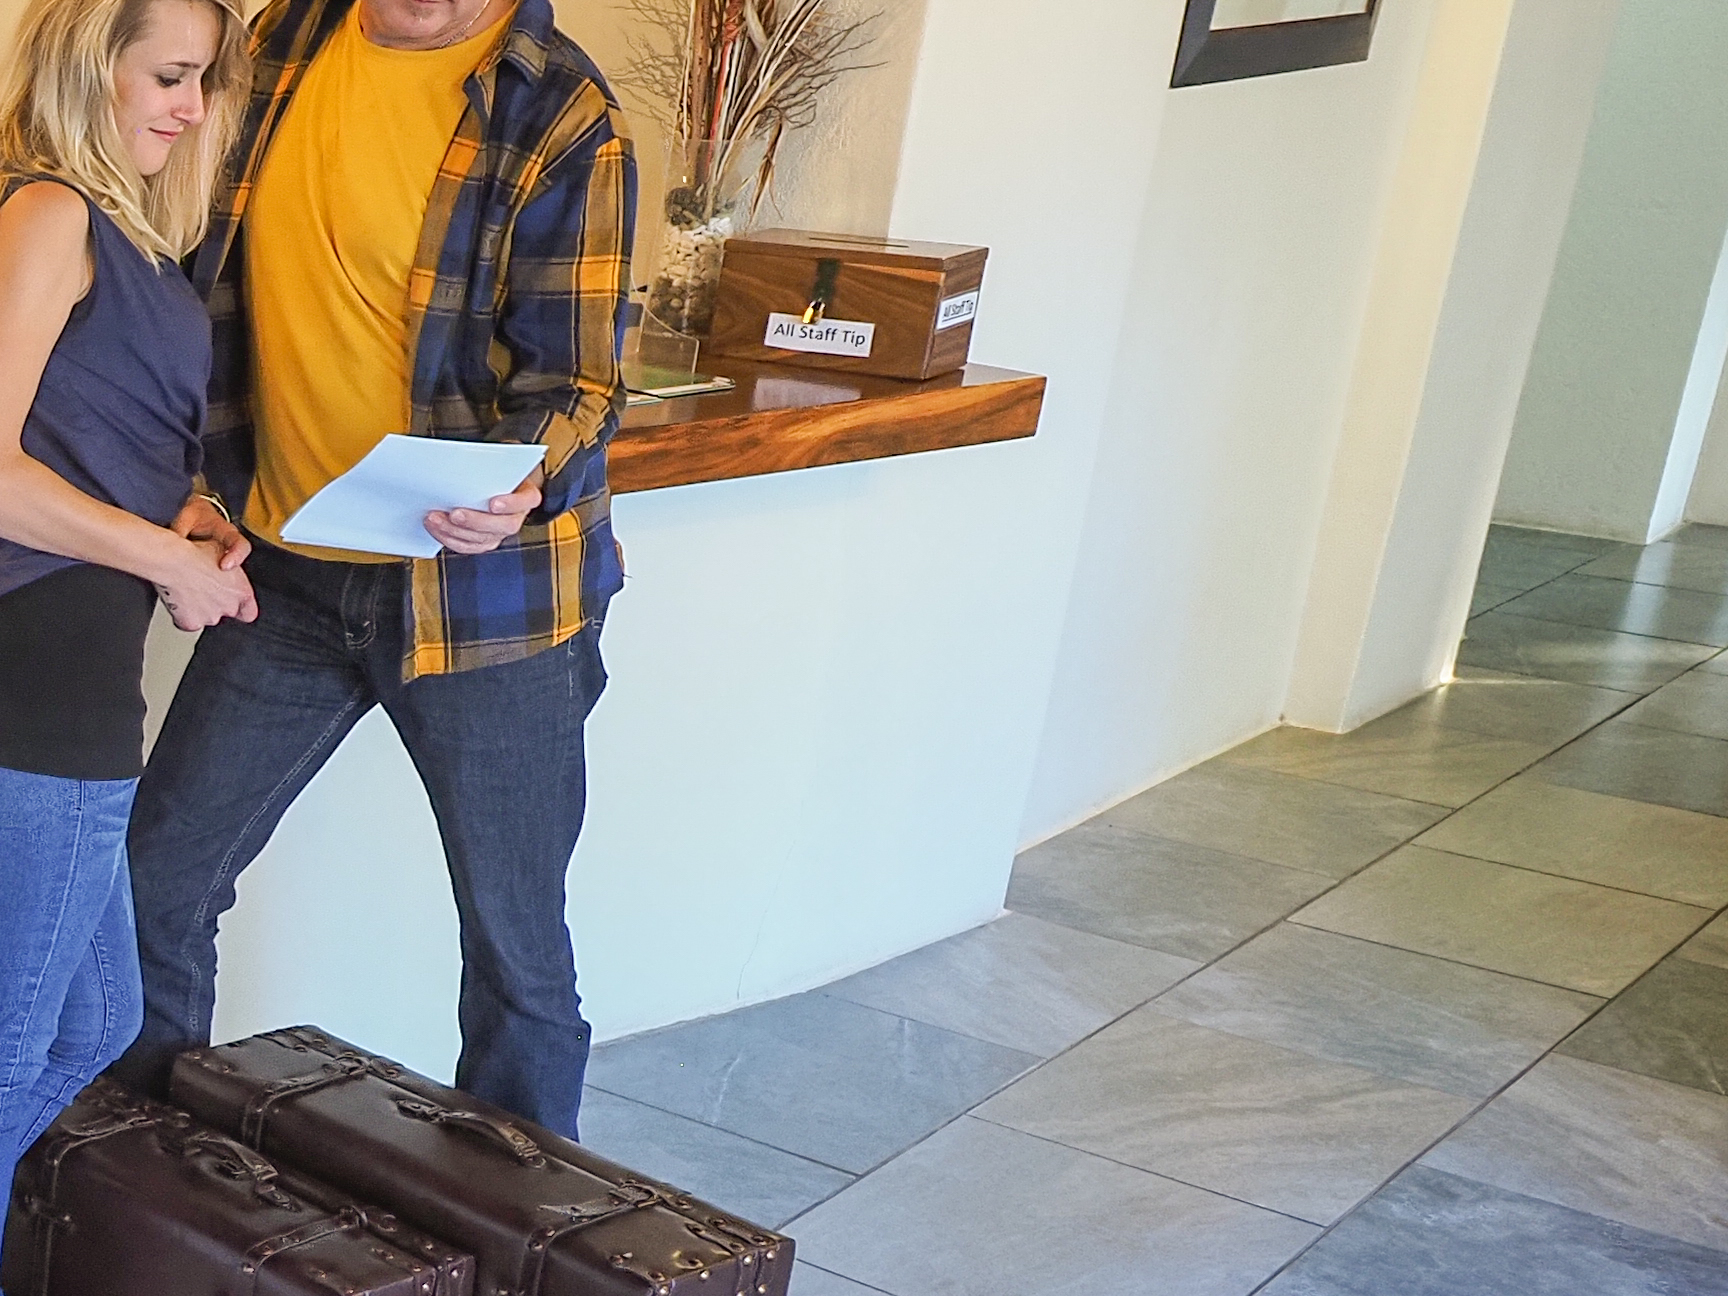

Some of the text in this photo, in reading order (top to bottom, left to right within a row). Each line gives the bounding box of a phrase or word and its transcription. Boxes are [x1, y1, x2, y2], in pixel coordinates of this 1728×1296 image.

[774, 323, 865, 347] All Staff Tip
